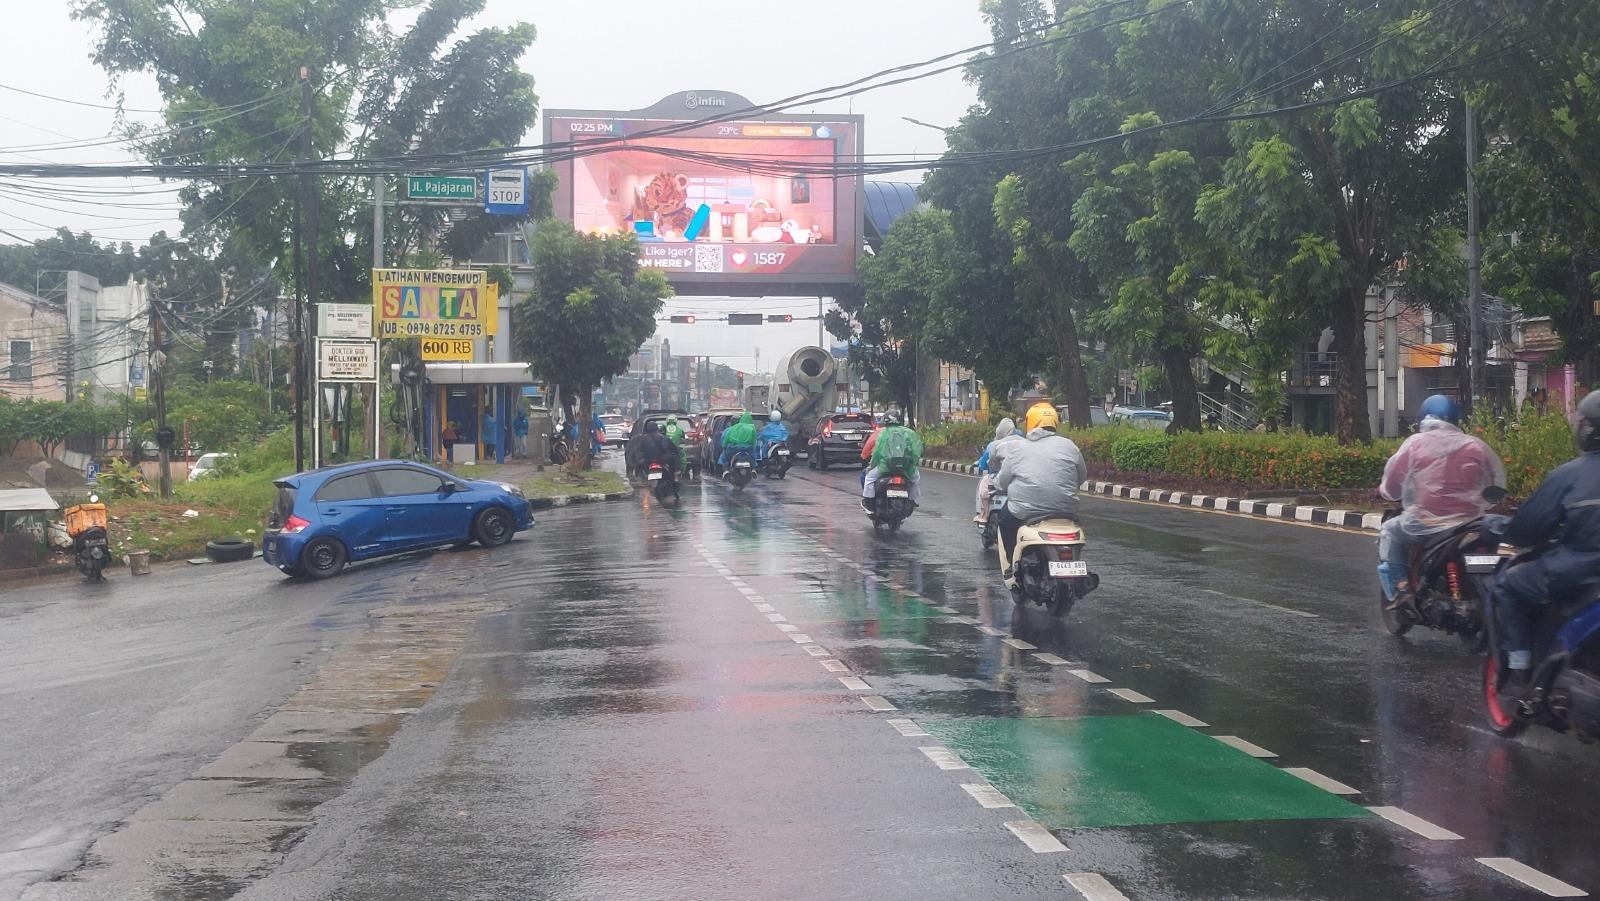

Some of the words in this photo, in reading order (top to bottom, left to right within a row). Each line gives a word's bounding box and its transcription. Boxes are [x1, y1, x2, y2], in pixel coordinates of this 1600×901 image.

[597, 123, 613, 133] PM
[425, 182, 473, 195] Pajajaran
[492, 190, 521, 202] STOP
[645, 246, 665, 256] Like
[668, 247, 694, 258] Iger?
[753, 252, 785, 265] 1587
[654, 259, 682, 268] HERE
[378, 272, 421, 282] LATIHAN
[423, 273, 482, 285] MENGEMUDI
[384, 288, 477, 317] SANTA
[406, 323, 430, 335] 0878
[433, 323, 456, 335] 8725
[459, 323, 482, 336] 4795
[422, 341, 449, 354] 600
[452, 341, 471, 354] RB
